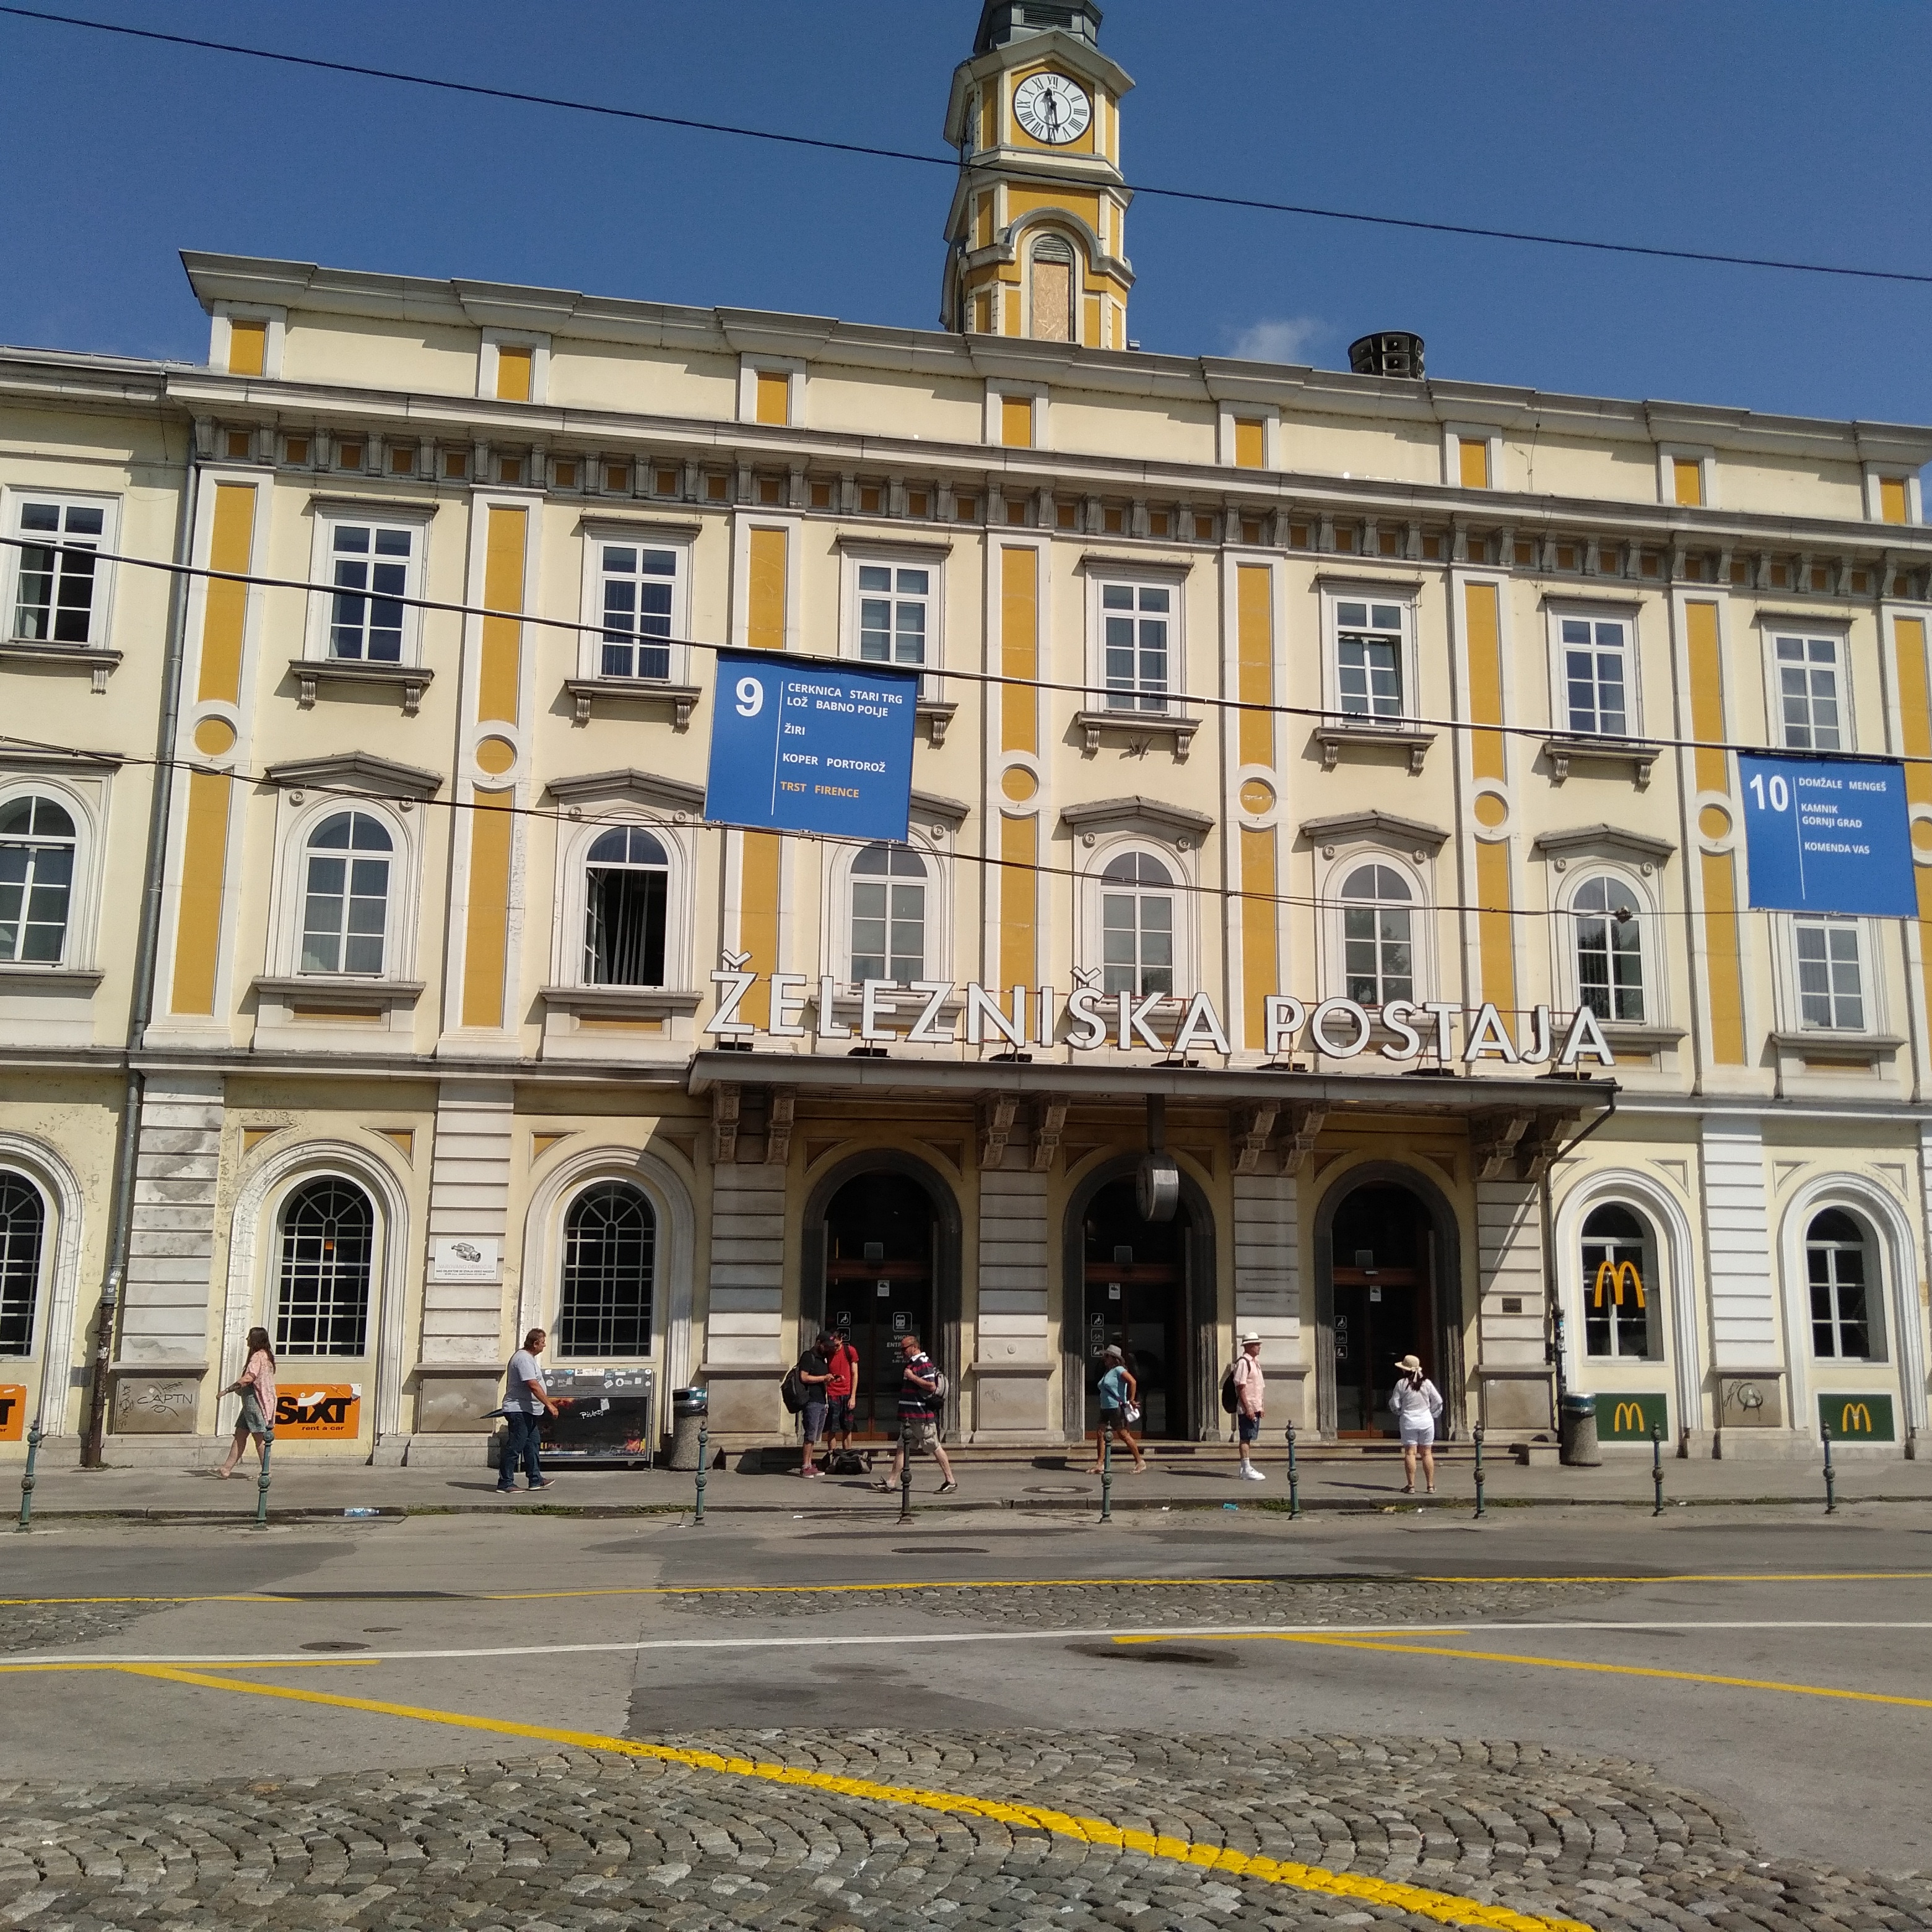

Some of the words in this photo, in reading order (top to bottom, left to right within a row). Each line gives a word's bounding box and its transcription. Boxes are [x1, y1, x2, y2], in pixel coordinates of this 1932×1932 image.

[1021, 86, 1035, 98] X
[1070, 94, 1084, 103] II
[1073, 108, 1087, 116] III
[736, 677, 764, 717] 9
[788, 683, 842, 697] CERKNICA
[850, 690, 879, 702] STARI
[882, 693, 903, 704] TRG
[787, 696, 808, 708] LOŽ
[816, 700, 855, 713] BABNO
[858, 704, 889, 718] POLJE
[784, 722, 806, 736] ŽIRI
[783, 753, 819, 765] KOPER
[827, 758, 886, 773] PORTOROŽ
[780, 781, 807, 793] TRST
[814, 785, 859, 798] FIRENCE
[1798, 777, 1842, 789] DOMŽALE
[1848, 781, 1887, 791] MENGEŠ
[1749, 773, 1789, 812] 10
[1801, 803, 1838, 814] KAMNIK
[1802, 816, 1835, 828] GORNJI
[1837, 818, 1863, 828] GRAD
[1804, 842, 1851, 853] KOMENDA
[1852, 844, 1870, 855] VAS
[703, 948, 1232, 1055] ŽELEZNIŠKA
[1264, 994, 1616, 1066] POSTAJA
